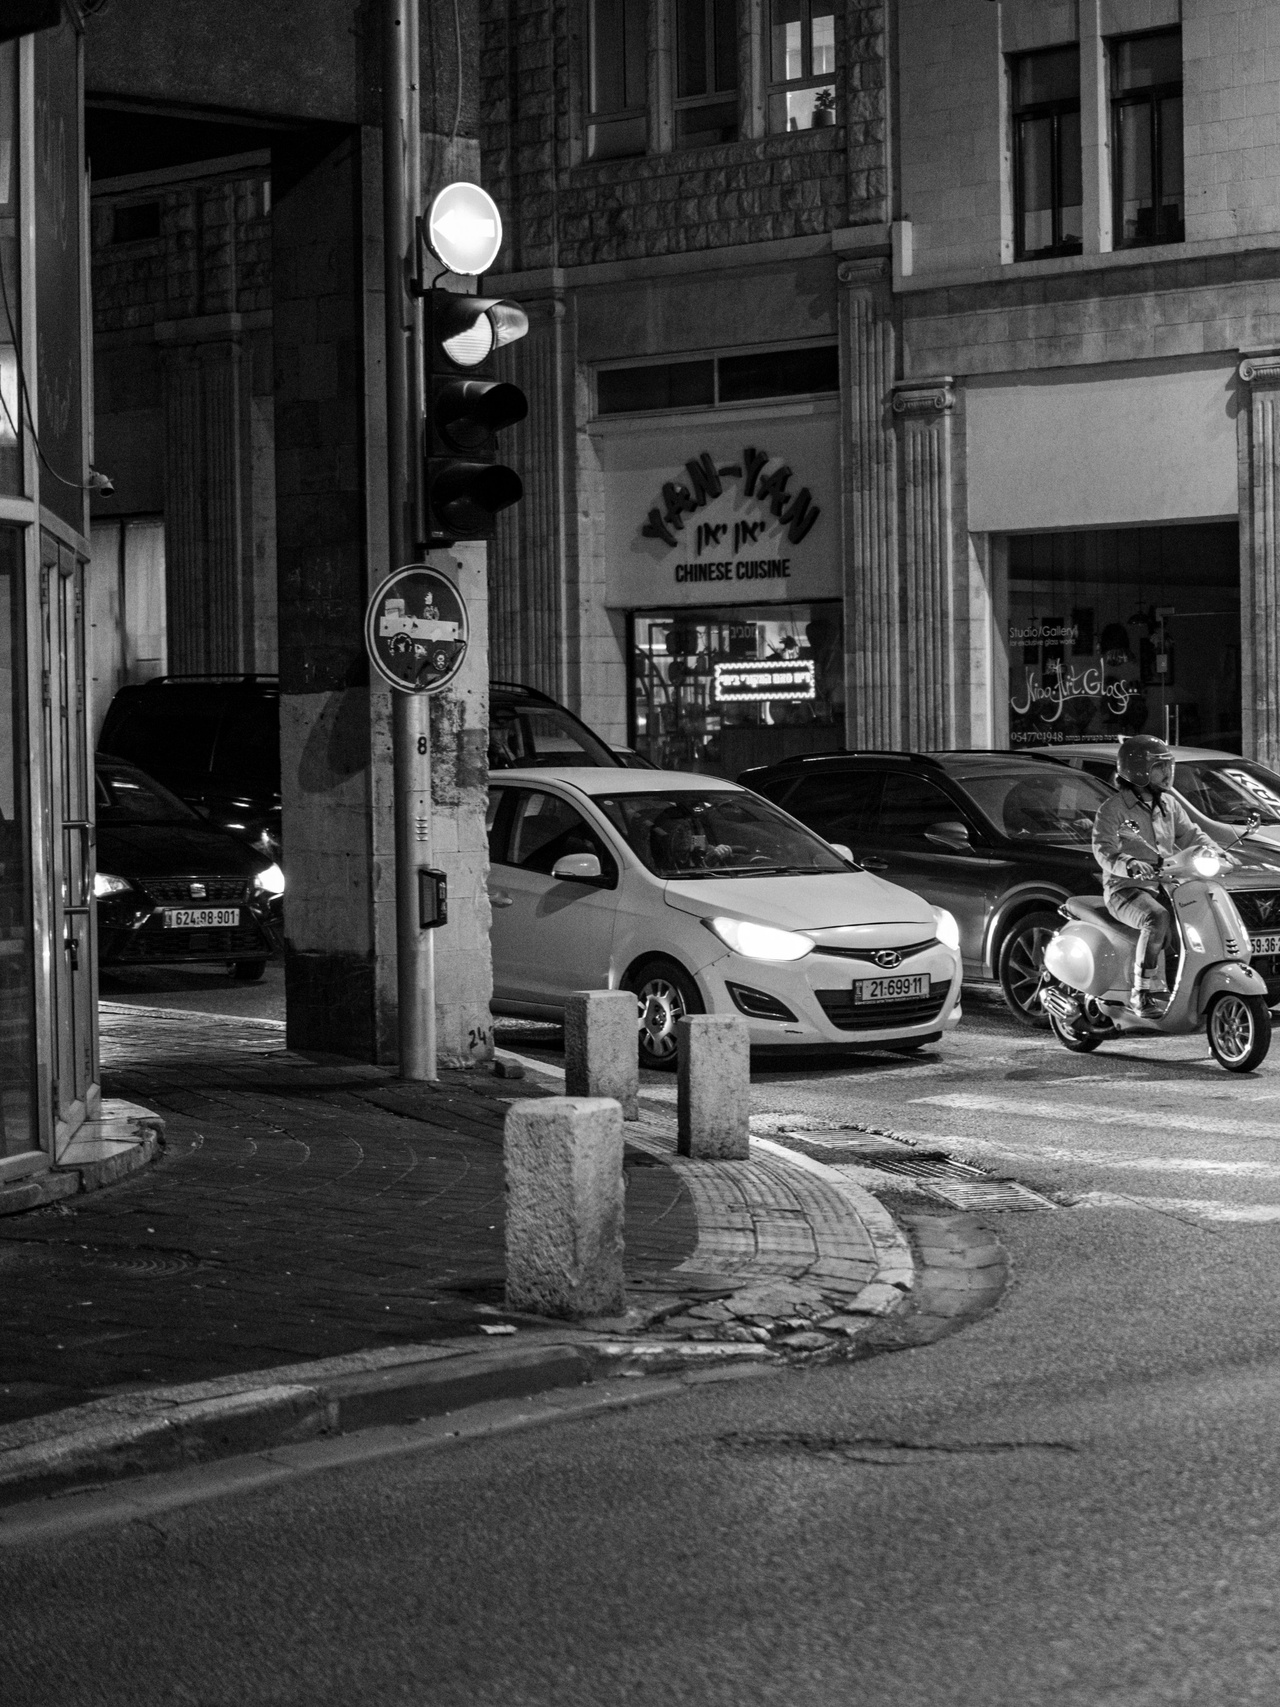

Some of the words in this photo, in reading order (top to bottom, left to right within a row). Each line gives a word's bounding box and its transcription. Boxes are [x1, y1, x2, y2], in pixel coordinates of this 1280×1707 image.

[641, 447, 820, 547] YAN-YAN
[697, 522, 728, 556] יאן
[734, 521, 766, 554] יאן
[676, 562, 733, 583] CHINESE
[736, 559, 791, 580] CUISINE
[417, 736, 427, 755] 8
